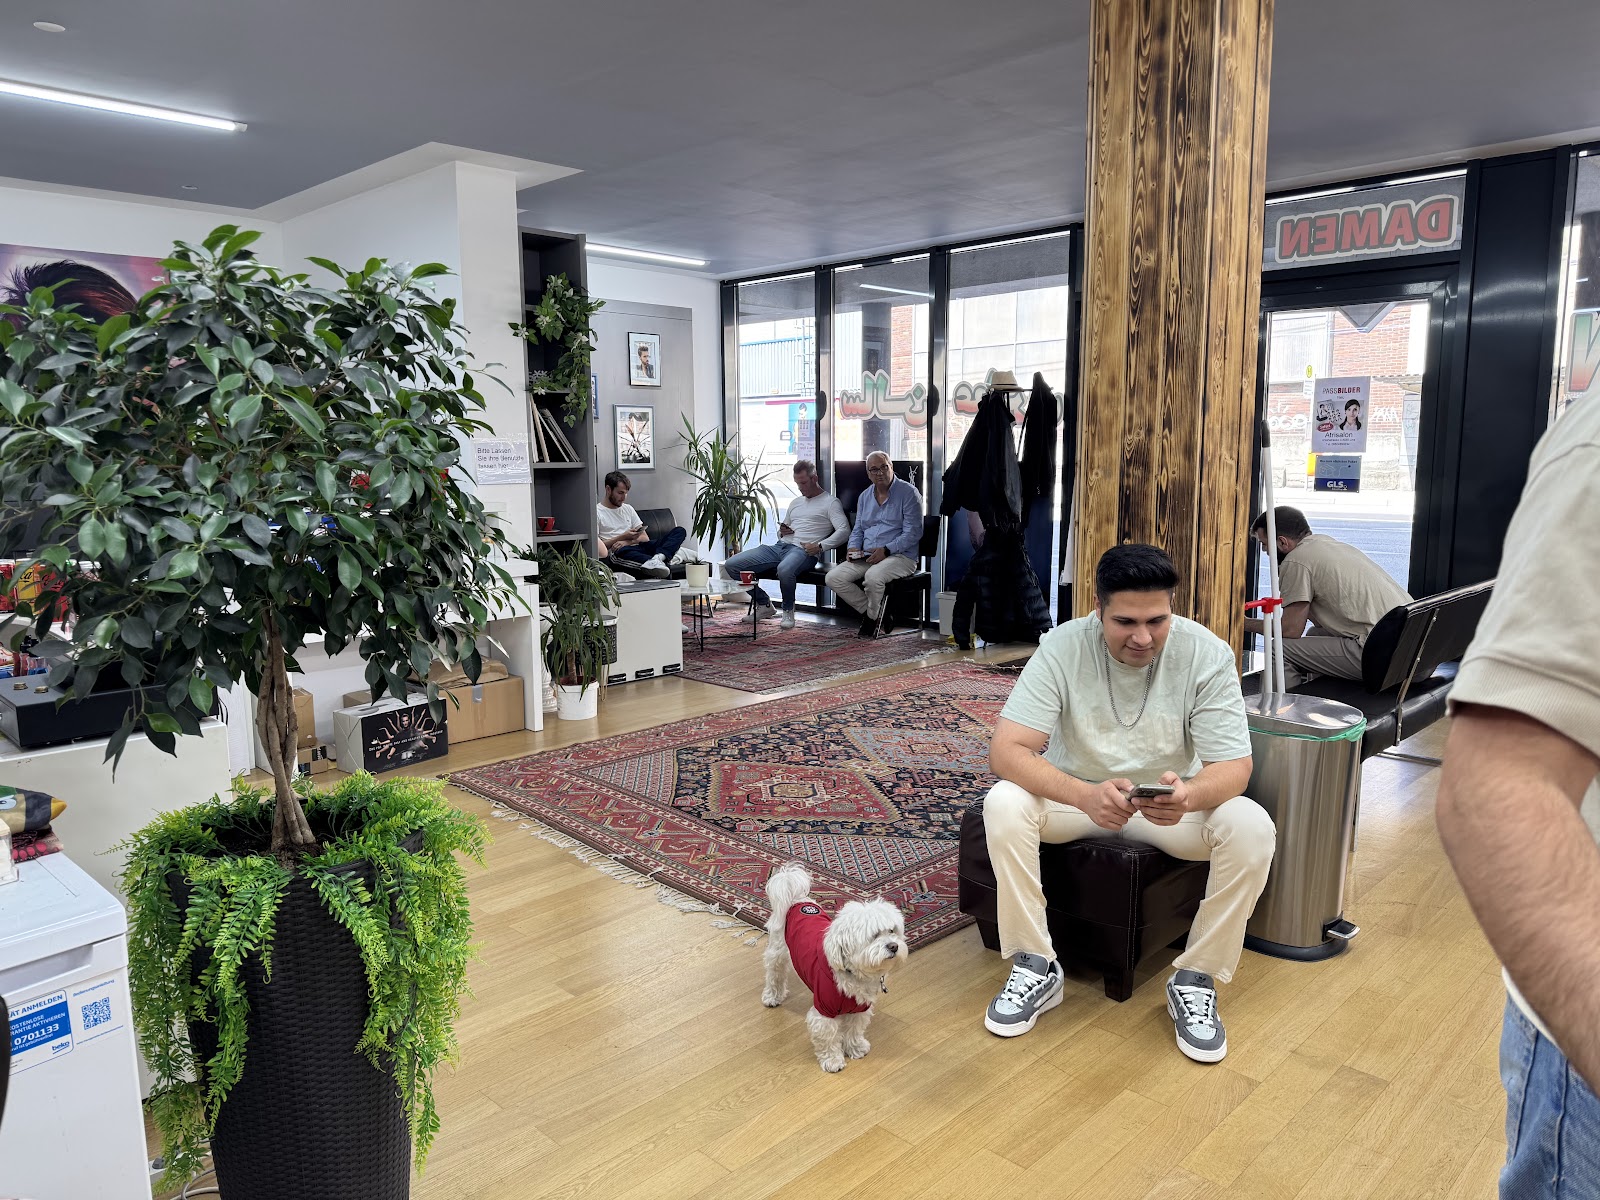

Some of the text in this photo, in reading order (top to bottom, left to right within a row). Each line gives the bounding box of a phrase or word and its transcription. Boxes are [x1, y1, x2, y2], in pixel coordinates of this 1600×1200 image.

[1322, 386, 1361, 395] PASSBILDER
[1326, 481, 1344, 489] GLS
[21, 994, 63, 1013] ANMELDEN
[32, 1012, 66, 1029] AKTIVIEREN
[14, 1023, 60, 1046] 0701133
[51, 1040, 70, 1051] beko
